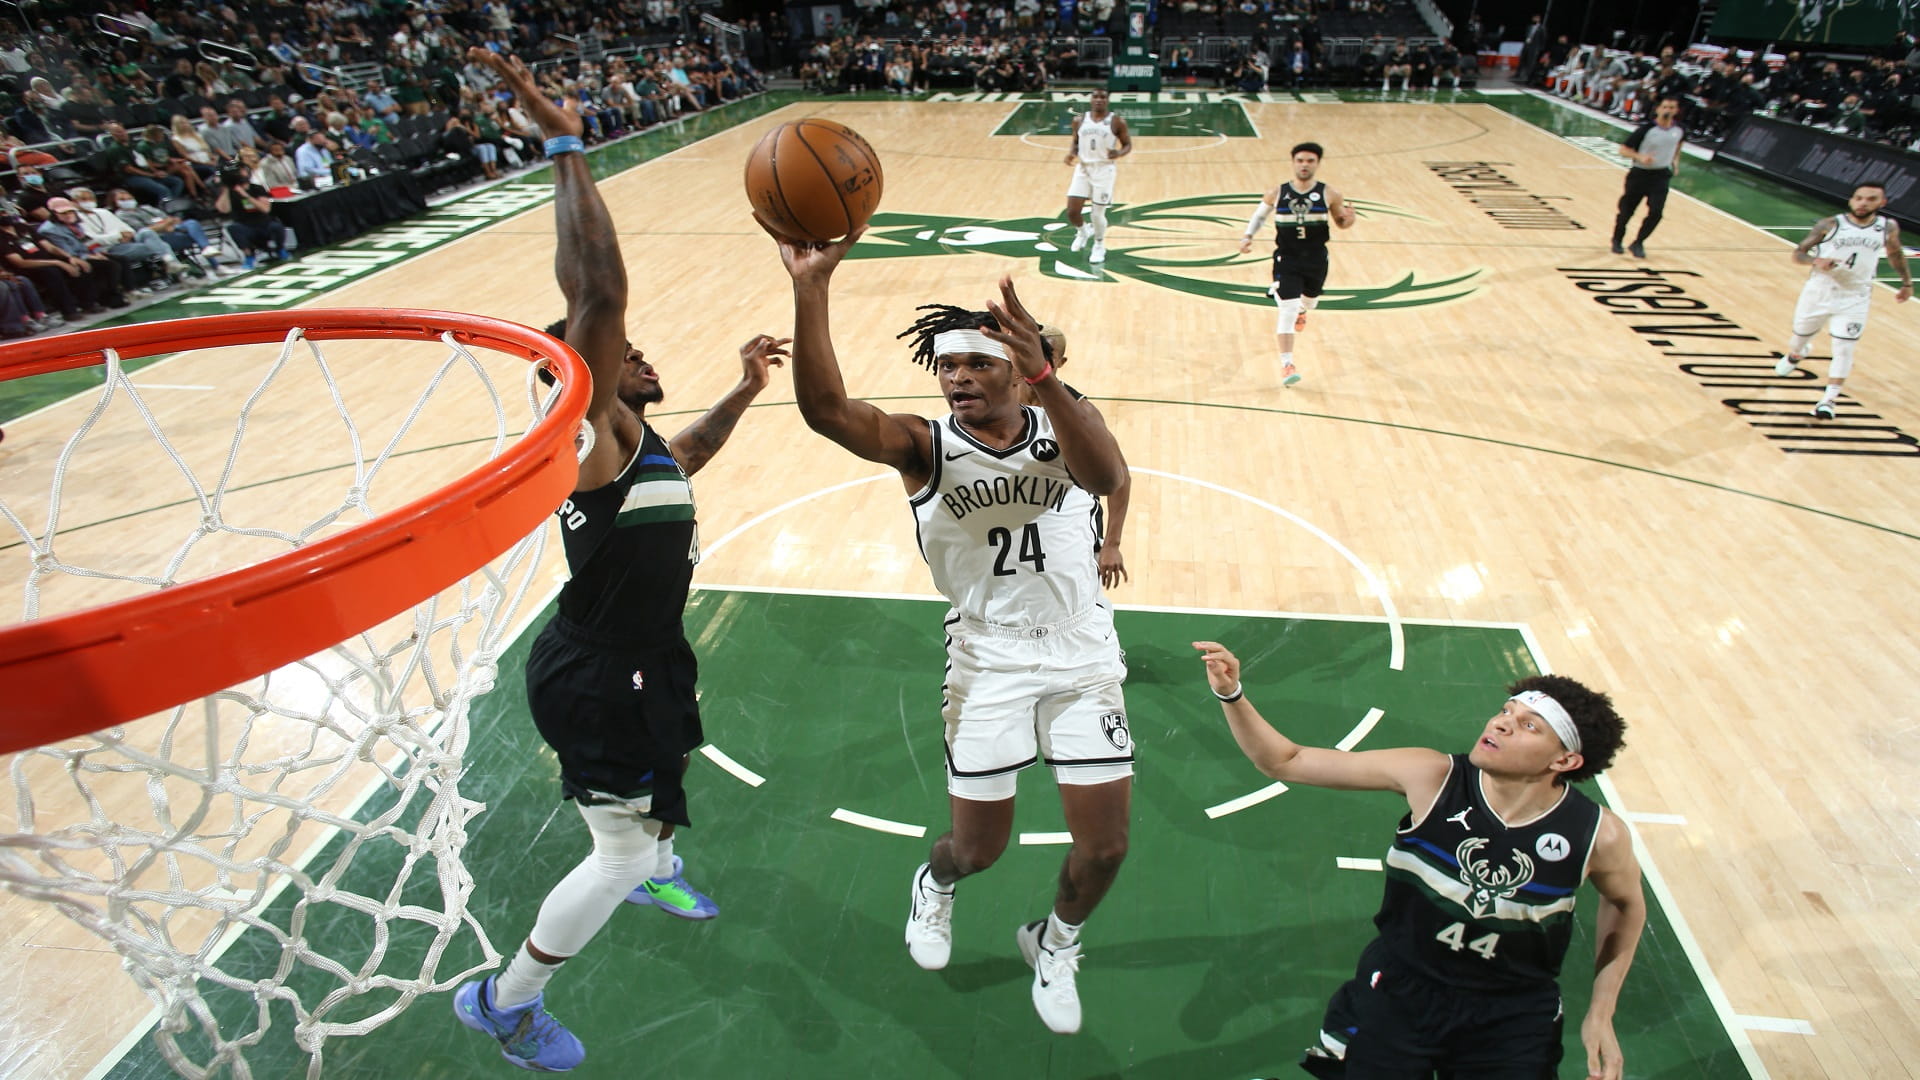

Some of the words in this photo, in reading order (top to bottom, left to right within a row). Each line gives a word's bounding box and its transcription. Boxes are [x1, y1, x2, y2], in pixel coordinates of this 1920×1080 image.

[926, 92, 1345, 104] MILWAUKEE
[1295, 226, 1307, 240] 3
[180, 250, 408, 306] DEER
[1845, 252, 1858, 269] 4
[941, 475, 1068, 520] BROOKLYN
[987, 522, 1047, 577] 24
[1436, 921, 1500, 960] 44
